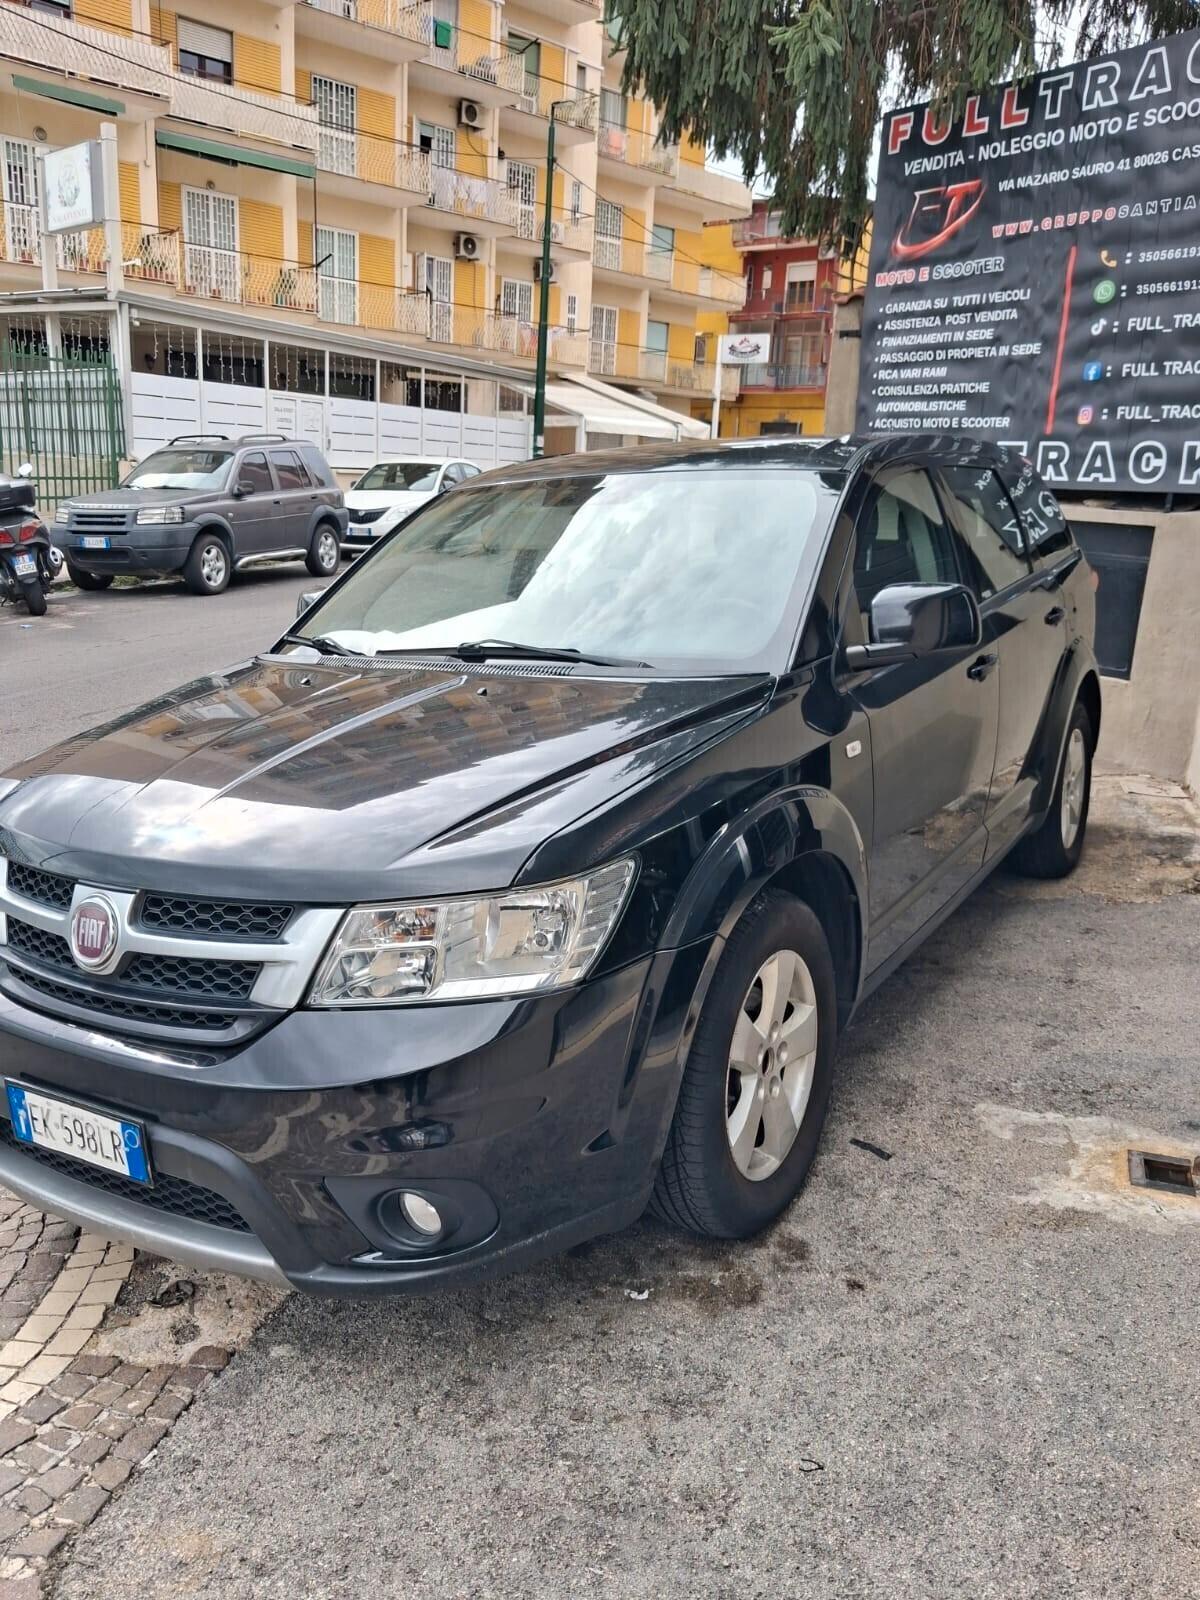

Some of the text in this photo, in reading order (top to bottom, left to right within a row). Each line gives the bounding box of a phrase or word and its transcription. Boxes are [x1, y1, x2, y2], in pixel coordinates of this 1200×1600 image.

[888, 86, 1030, 154] FULL
[904, 150, 965, 176] VENDITA
[978, 129, 1064, 161] NOLEGGIO
[1069, 116, 1122, 144] MOTO
[1126, 112, 1140, 131] E
[998, 179, 1014, 192] VIA
[1017, 170, 1069, 188] NAZARIO
[1072, 161, 1114, 179] SAURO
[1117, 158, 1131, 171] 41
[1133, 151, 1169, 168] 80026
[875, 256, 1004, 287] MOTO E SCOOTER
[1136, 279, 1200, 295] 350566191
[885, 288, 1031, 314] GARANZIA SU TUTTI I VEICOLI
[884, 308, 1018, 331] ASSISTENZA POST VENDITA
[882, 329, 994, 347] FINANZIAMENTI IN SEDE
[880, 343, 1042, 364] PASSAGGIO DI PROPIETA IN SEDE
[878, 367, 947, 380] RCA VARI RAMI
[1122, 362, 1159, 377] FULL
[877, 382, 990, 396] CONSULENZA PRATICHE
[876, 400, 967, 412] AUTOMOBILISTICHE
[874, 416, 1010, 429] ACQUISTO MOTO E SCOOTER
[79, 917, 105, 949] FIAT
